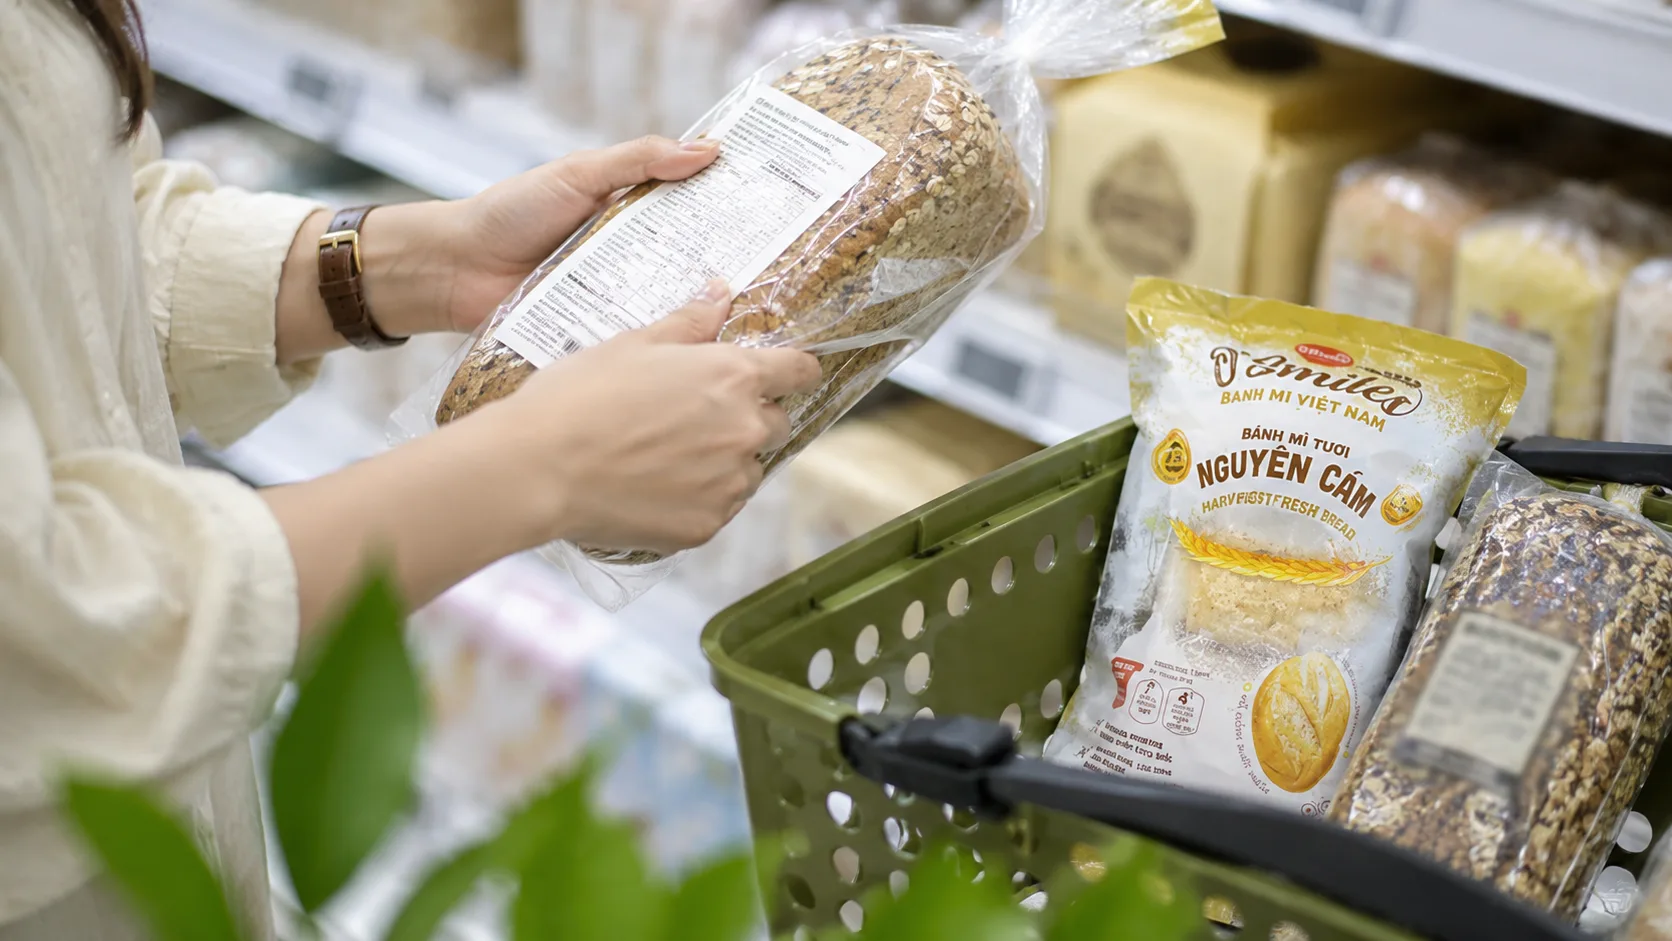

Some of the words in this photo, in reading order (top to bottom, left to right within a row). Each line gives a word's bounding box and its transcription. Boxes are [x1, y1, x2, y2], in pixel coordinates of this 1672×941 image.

[1344, 405, 1386, 432] NAM
[1241, 425, 1284, 442] BÁNH
[1288, 432, 1309, 446] MÌ
[1196, 445, 1313, 489] NGUYÊN
[1320, 509, 1356, 541] BREAD
